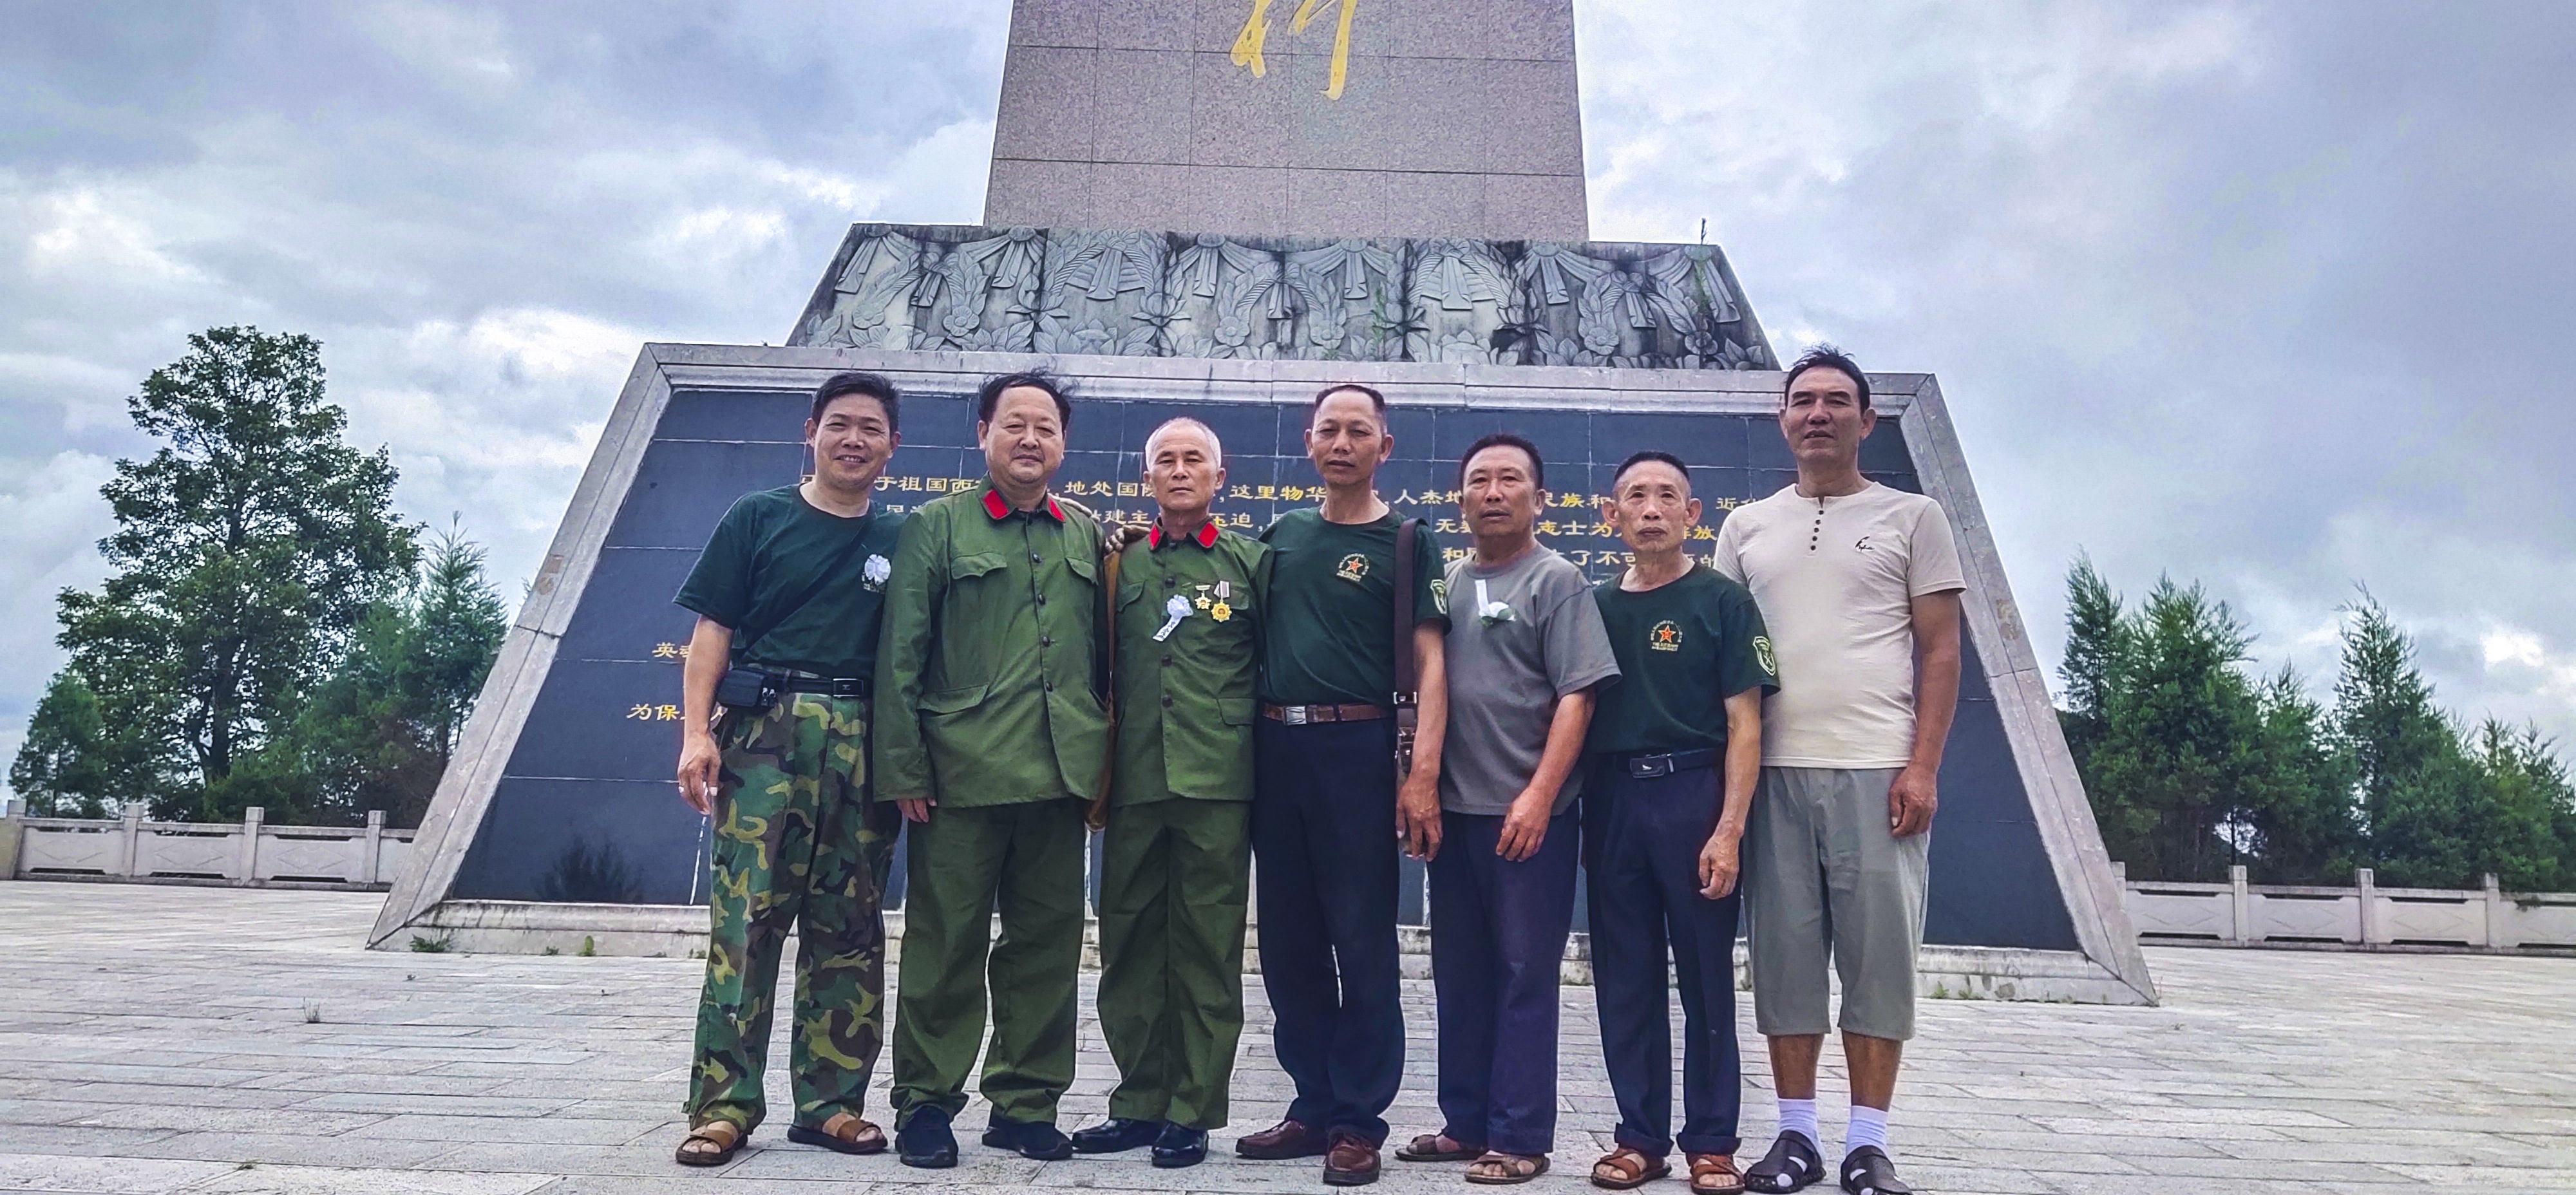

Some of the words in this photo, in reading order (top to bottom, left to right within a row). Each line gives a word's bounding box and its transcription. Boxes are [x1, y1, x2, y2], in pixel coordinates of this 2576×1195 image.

[874, 475, 982, 493] 于祖国西
[1553, 549, 1635, 567] 了不可
[626, 703, 685, 721] 为保
